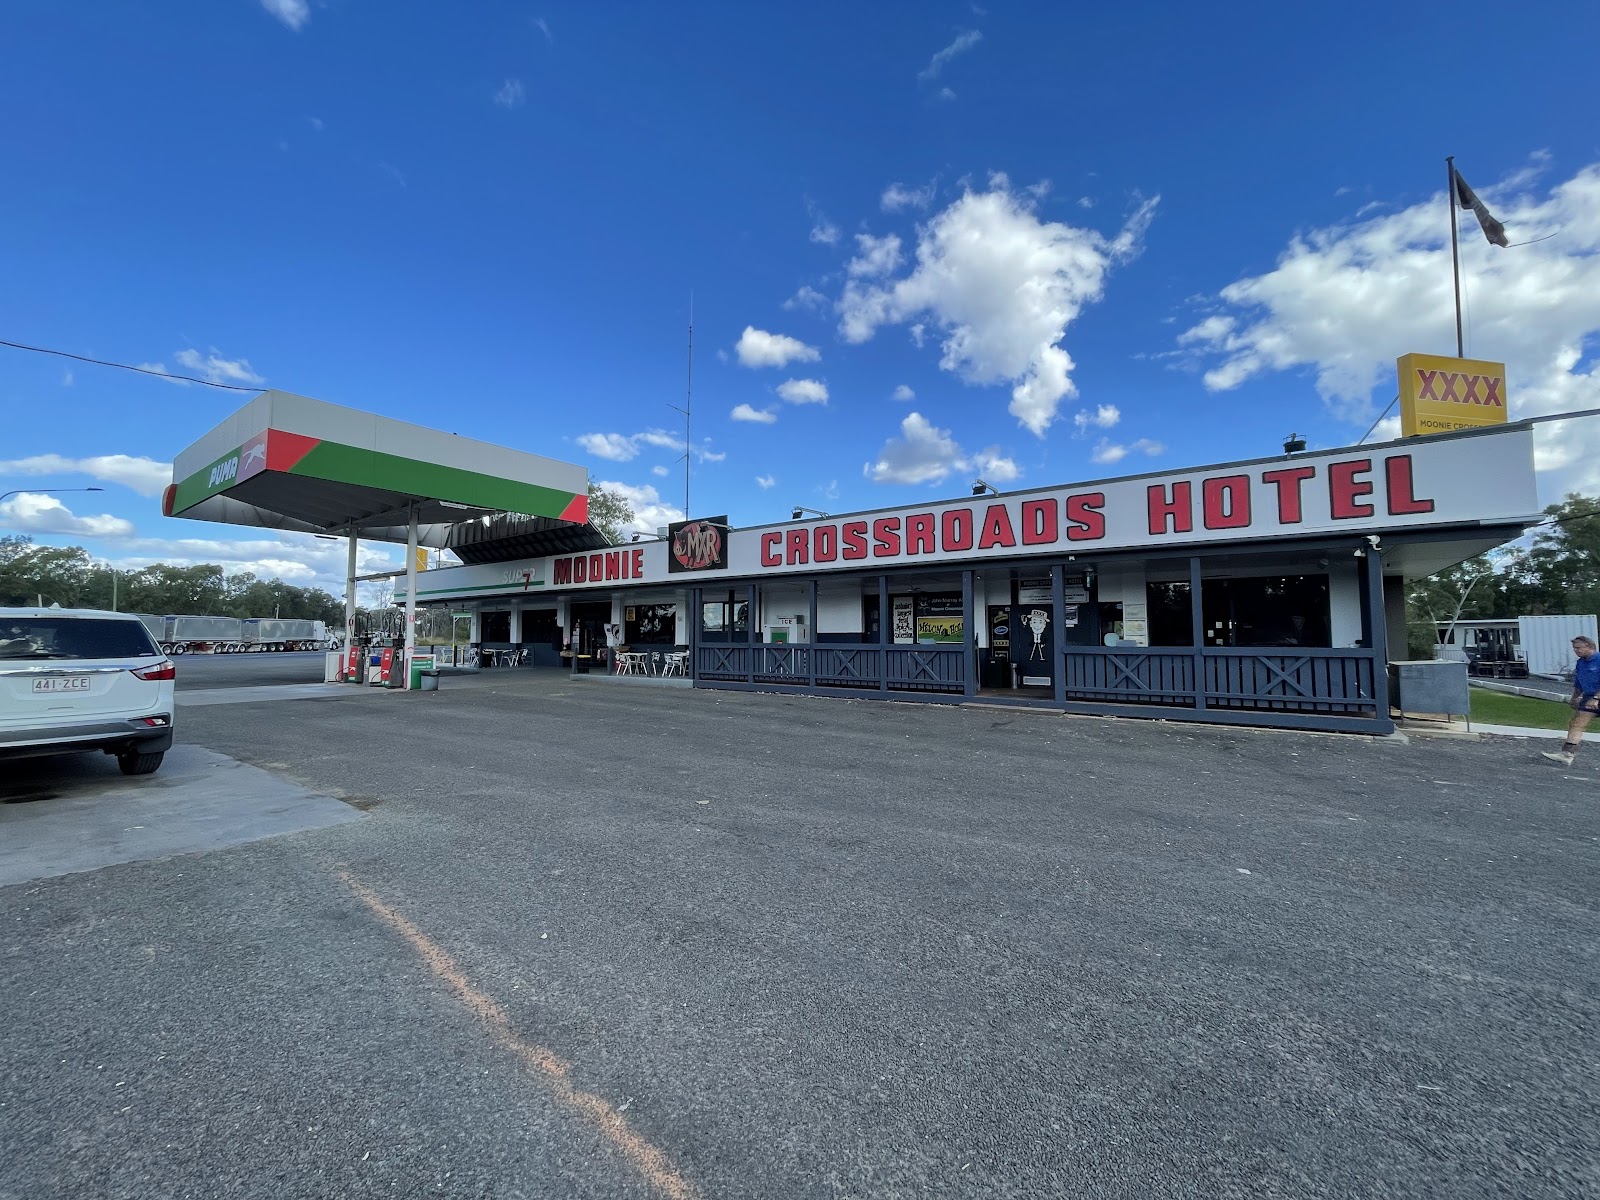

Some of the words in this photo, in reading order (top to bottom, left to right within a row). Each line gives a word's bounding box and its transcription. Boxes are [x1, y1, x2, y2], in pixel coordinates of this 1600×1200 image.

[1415, 368, 1502, 407] XXXX
[1420, 420, 1452, 430] MOONIE
[208, 457, 238, 488] PUMA
[553, 550, 643, 585] MOONIE
[761, 492, 1105, 567] CROSSROADS
[1147, 454, 1435, 536] HOTEL
